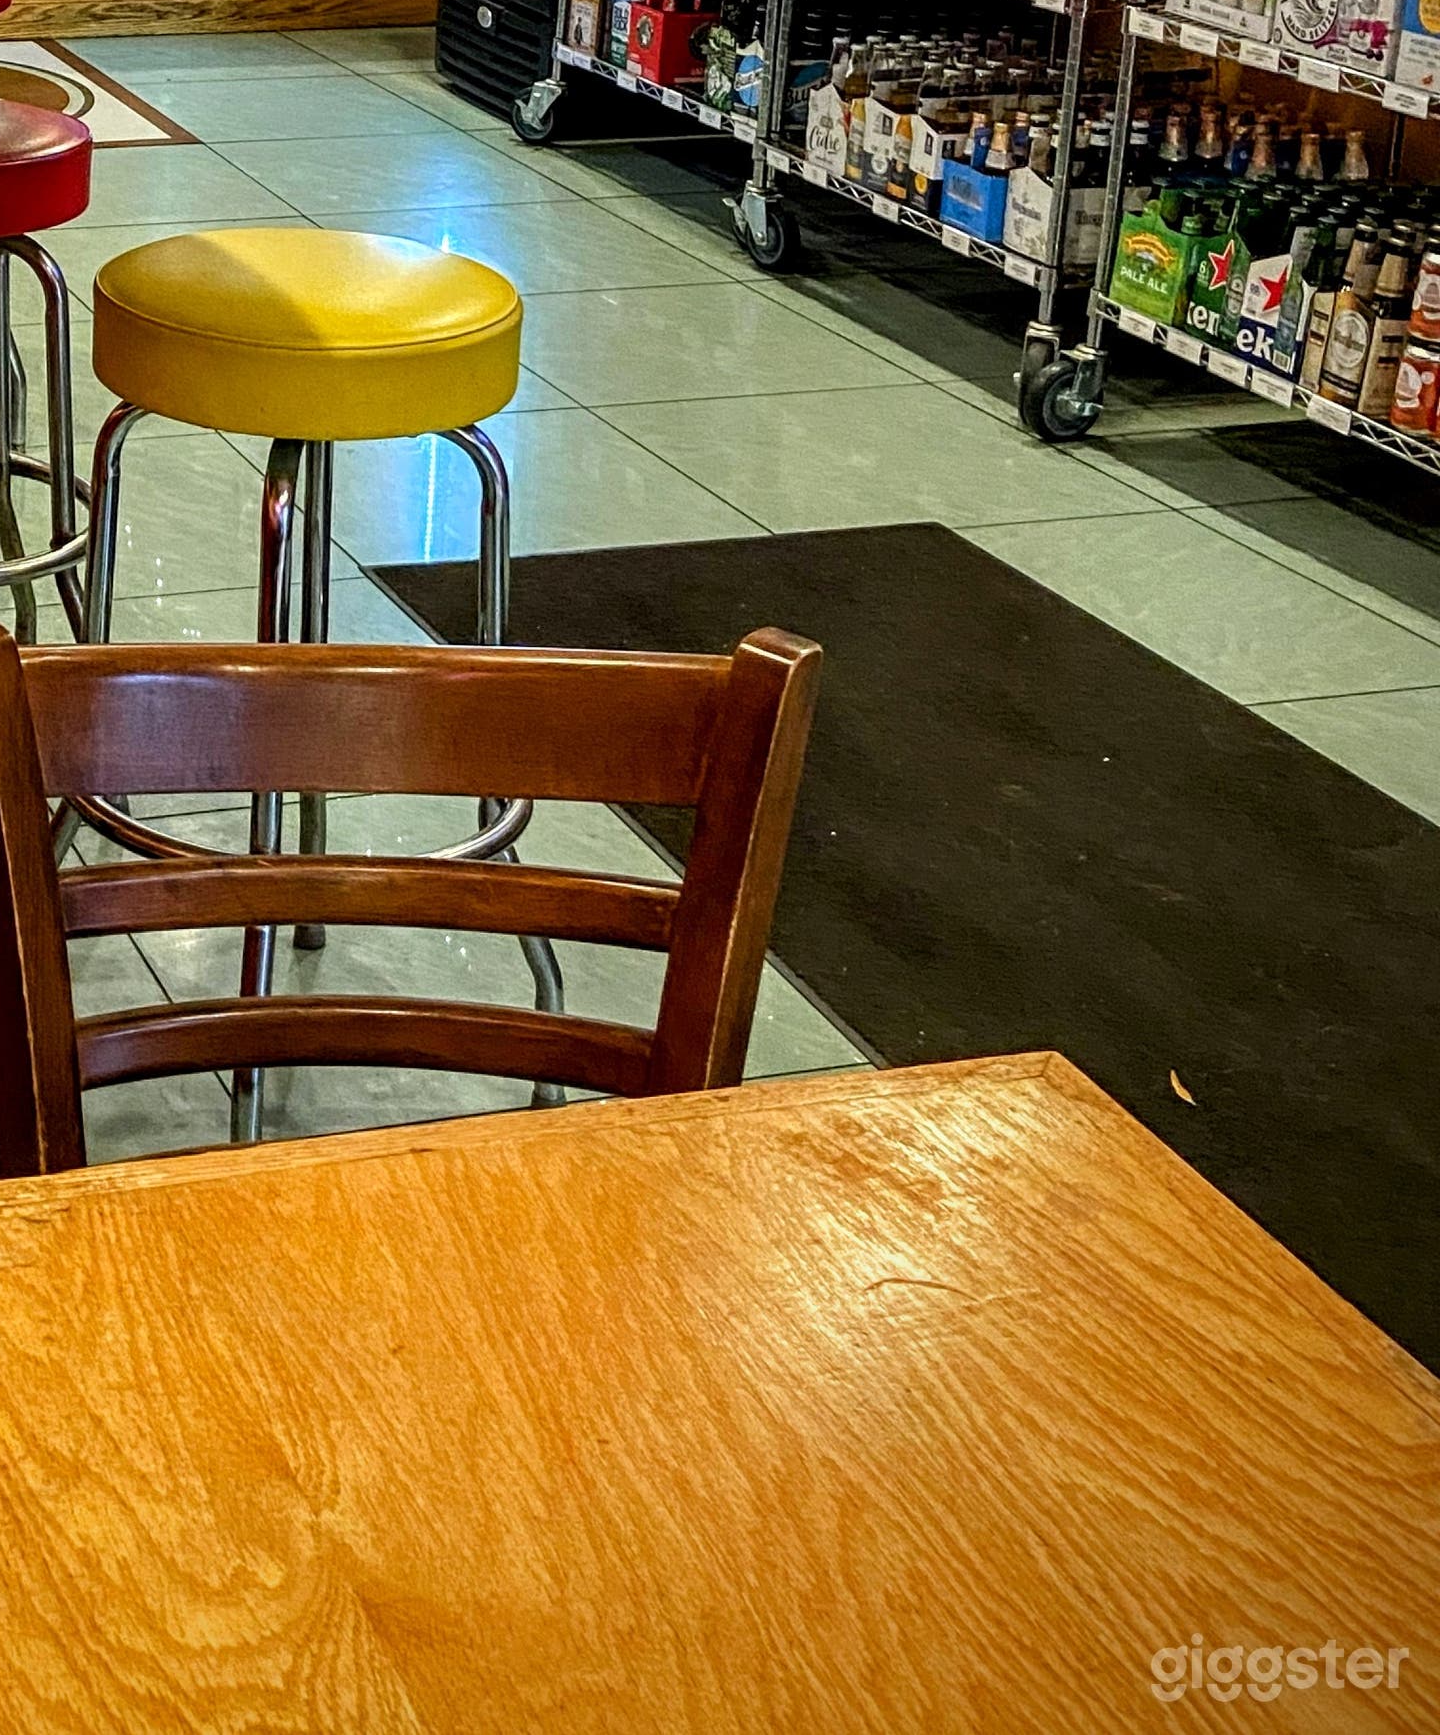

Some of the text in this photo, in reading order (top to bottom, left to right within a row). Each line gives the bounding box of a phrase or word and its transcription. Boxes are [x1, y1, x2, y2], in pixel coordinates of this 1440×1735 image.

[1285, 15, 1306, 39] HARD
[1121, 266, 1168, 295] PALE ALE
[1186, 300, 1220, 337] en
